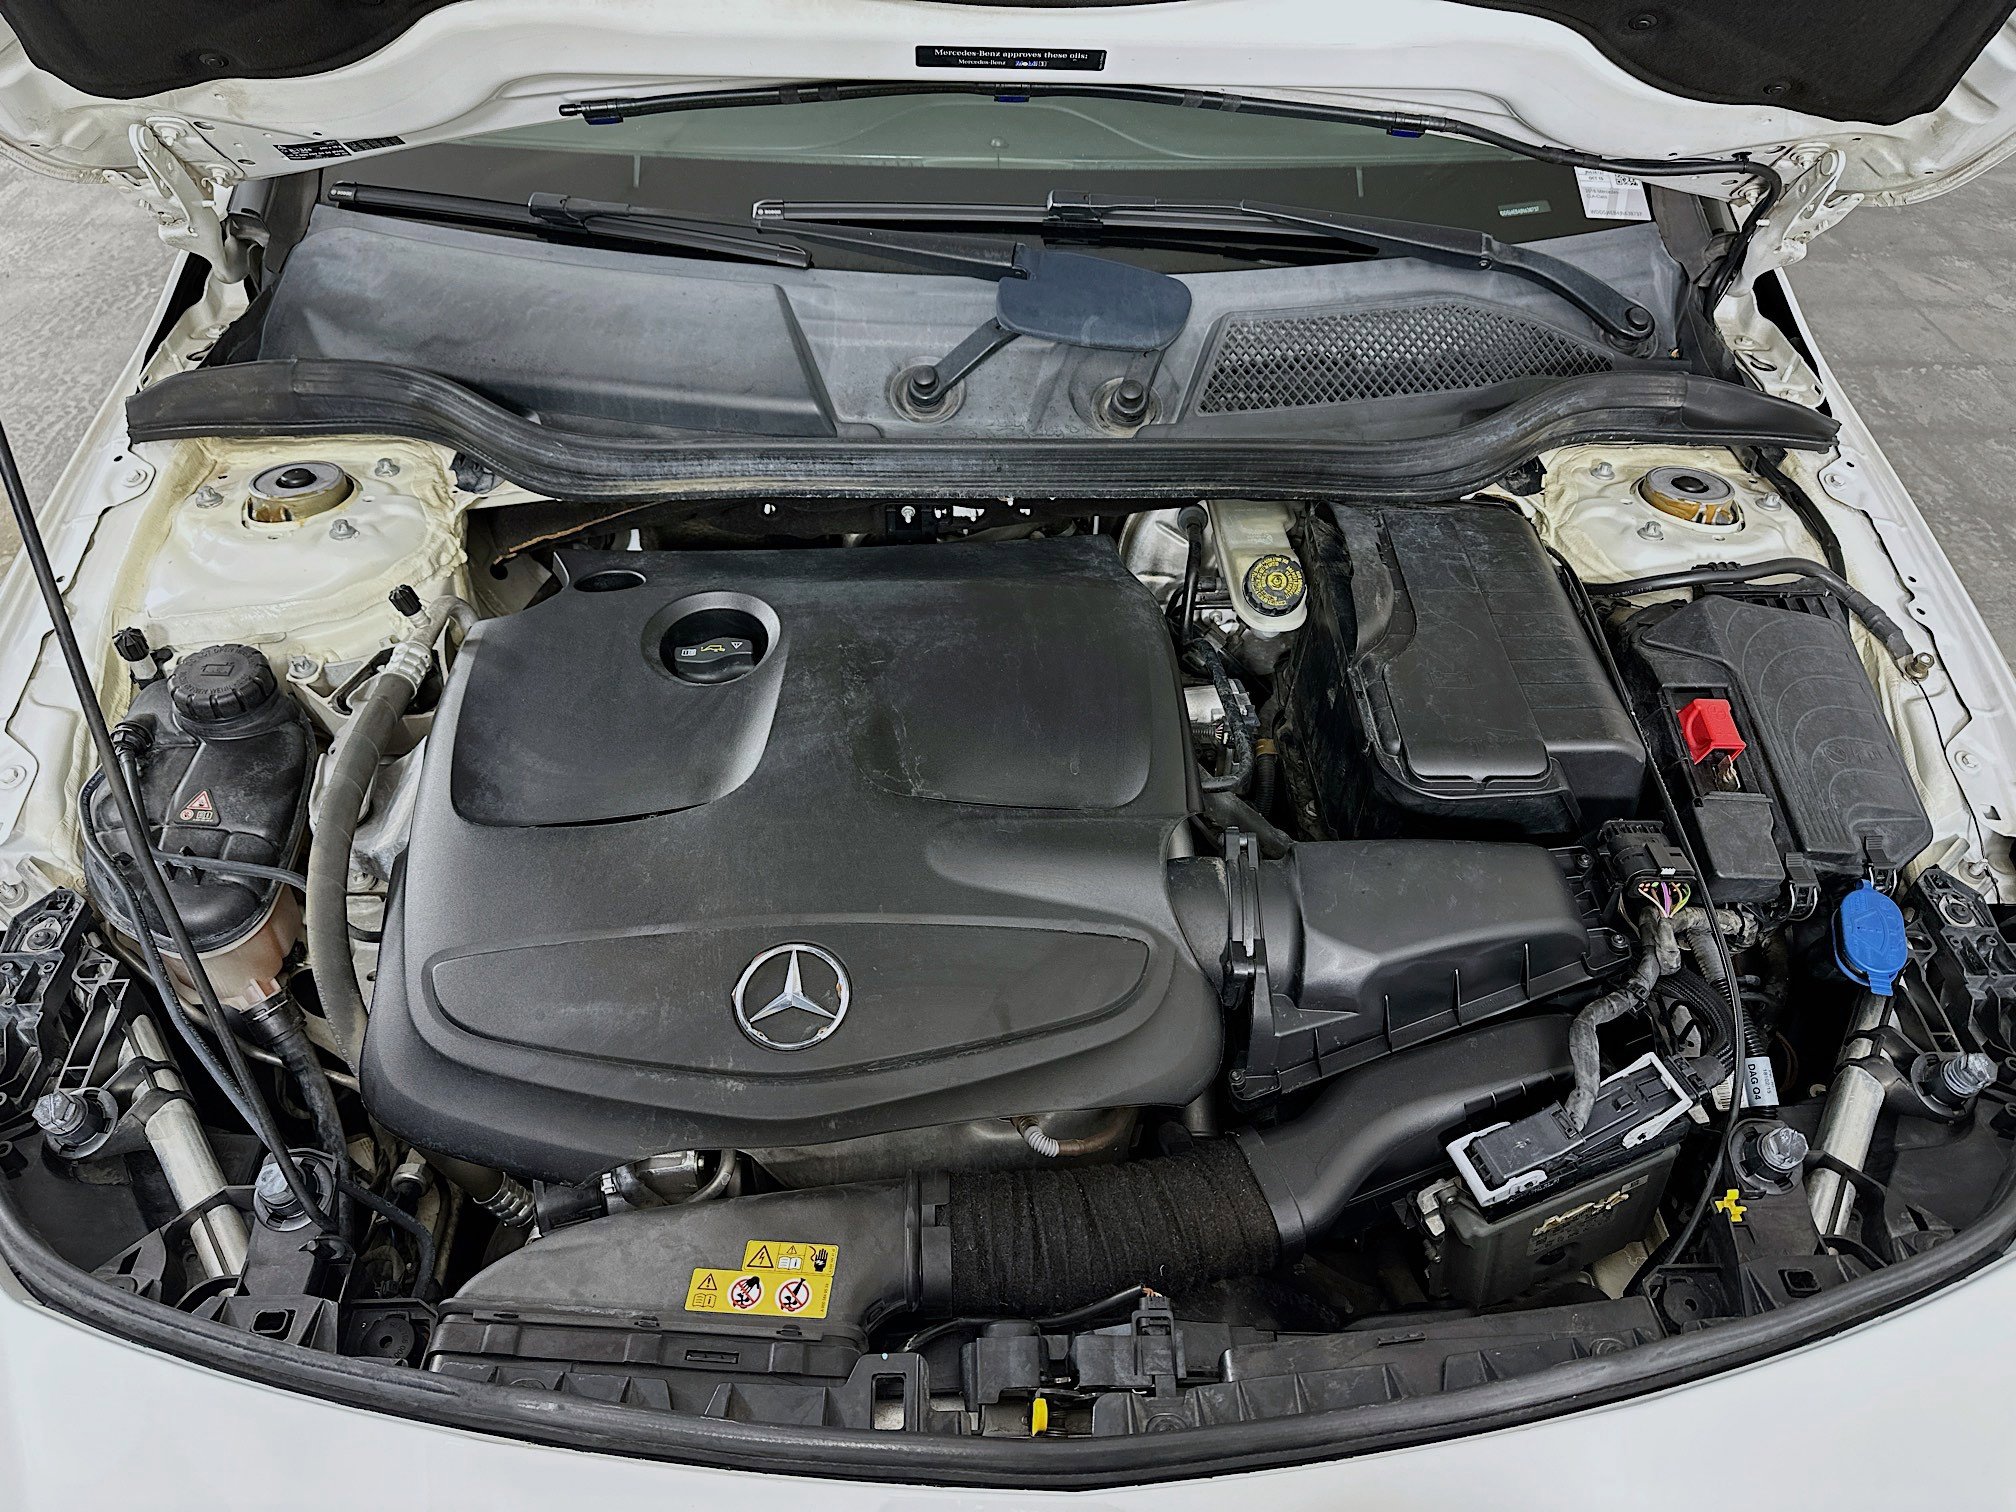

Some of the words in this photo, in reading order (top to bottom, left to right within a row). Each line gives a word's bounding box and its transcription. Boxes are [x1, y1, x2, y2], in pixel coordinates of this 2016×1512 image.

[934, 48, 1001, 58] Mercedes-Benz
[1002, 51, 1042, 60] approves
[1044, 52, 1068, 60] these
[1748, 1064, 1759, 1084] DAG
